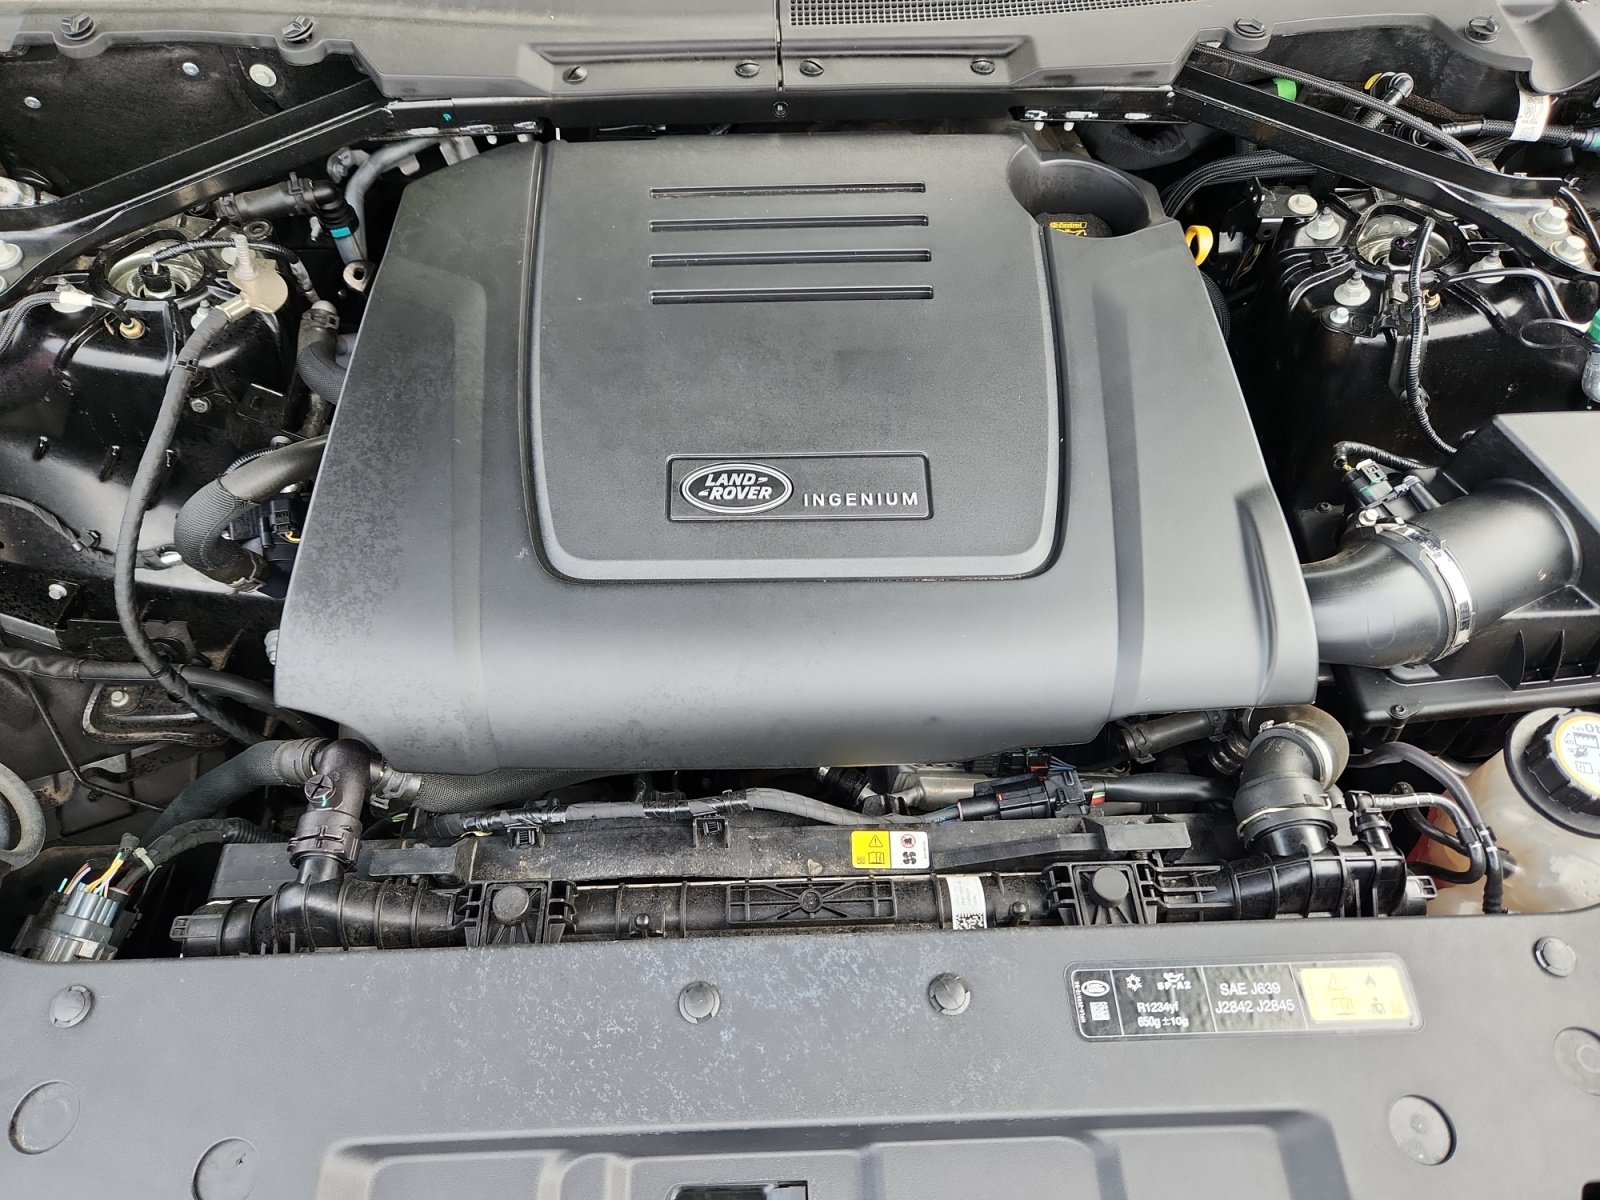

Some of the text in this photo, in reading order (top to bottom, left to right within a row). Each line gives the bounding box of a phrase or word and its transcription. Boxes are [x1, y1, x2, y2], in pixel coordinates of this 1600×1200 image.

[704, 473, 756, 487] LAND
[707, 486, 773, 501] ROVER
[803, 491, 919, 507] INGENIUM
[1219, 981, 1281, 996] SAE J639
[1136, 1001, 1179, 1014] R1234yf
[1215, 999, 1296, 1014] J2842 J2845
[1137, 1015, 1162, 1029] 650g
